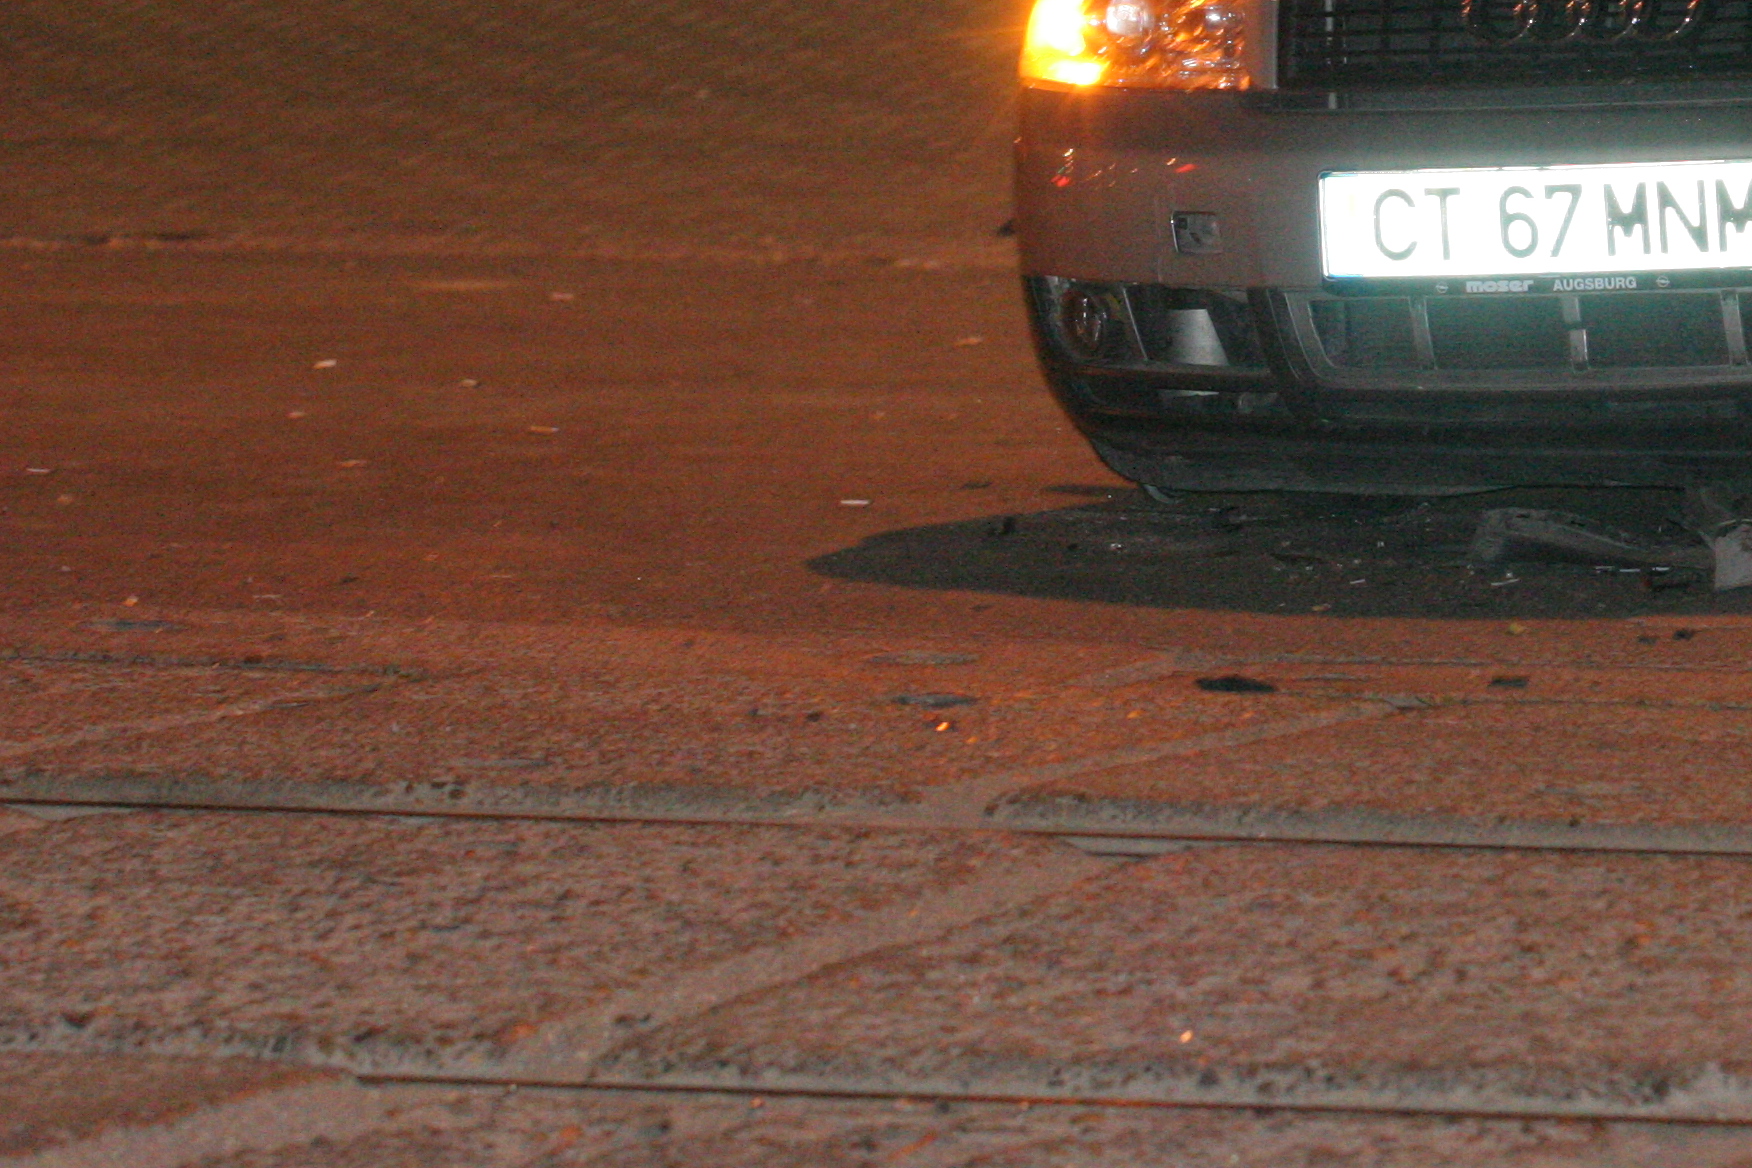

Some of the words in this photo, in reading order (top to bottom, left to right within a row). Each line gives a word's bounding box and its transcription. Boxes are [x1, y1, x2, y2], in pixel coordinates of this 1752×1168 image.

[1373, 187, 1461, 261] CT
[1500, 183, 1583, 259] 67
[1465, 279, 1534, 293] moser
[1552, 276, 1638, 292] AUGSBURG
